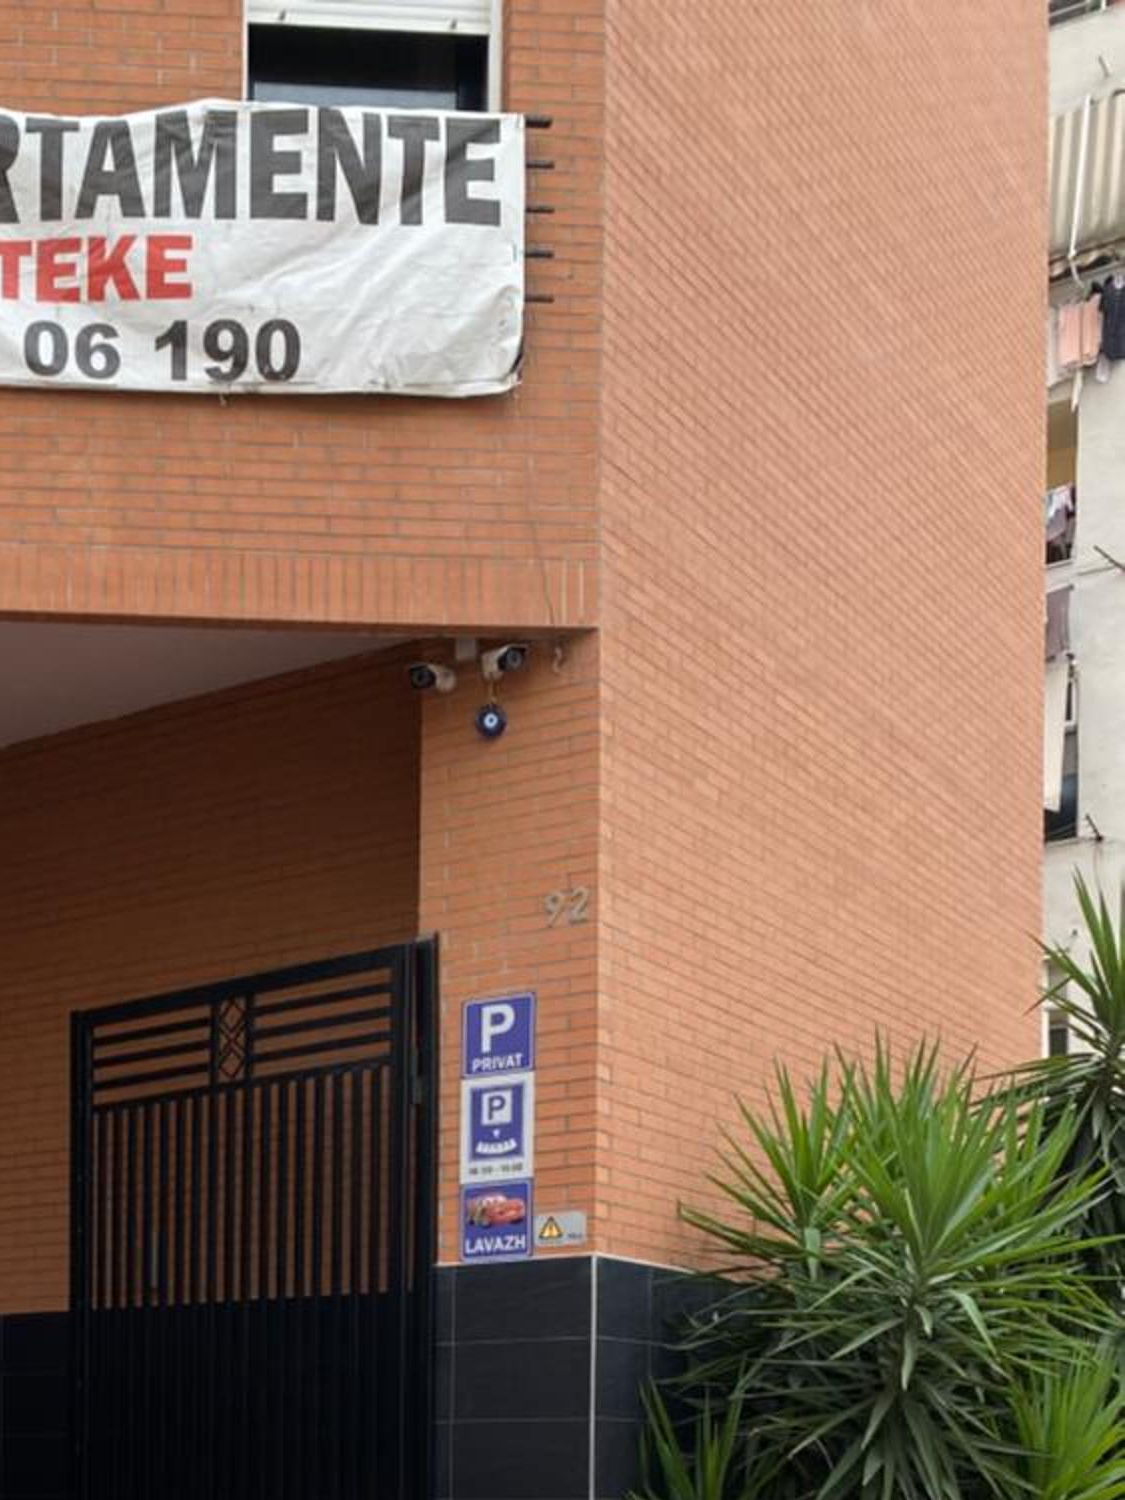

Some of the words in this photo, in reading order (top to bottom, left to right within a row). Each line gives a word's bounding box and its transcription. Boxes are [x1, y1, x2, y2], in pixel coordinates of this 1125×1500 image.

[23, 318, 122, 380] 06
[154, 318, 302, 382] 190
[544, 887, 588, 926] 92
[481, 1003, 515, 1053] P
[472, 1053, 523, 1073] PRIVAT
[488, 1095, 506, 1120] P
[465, 1235, 526, 1254] LAVAZH
